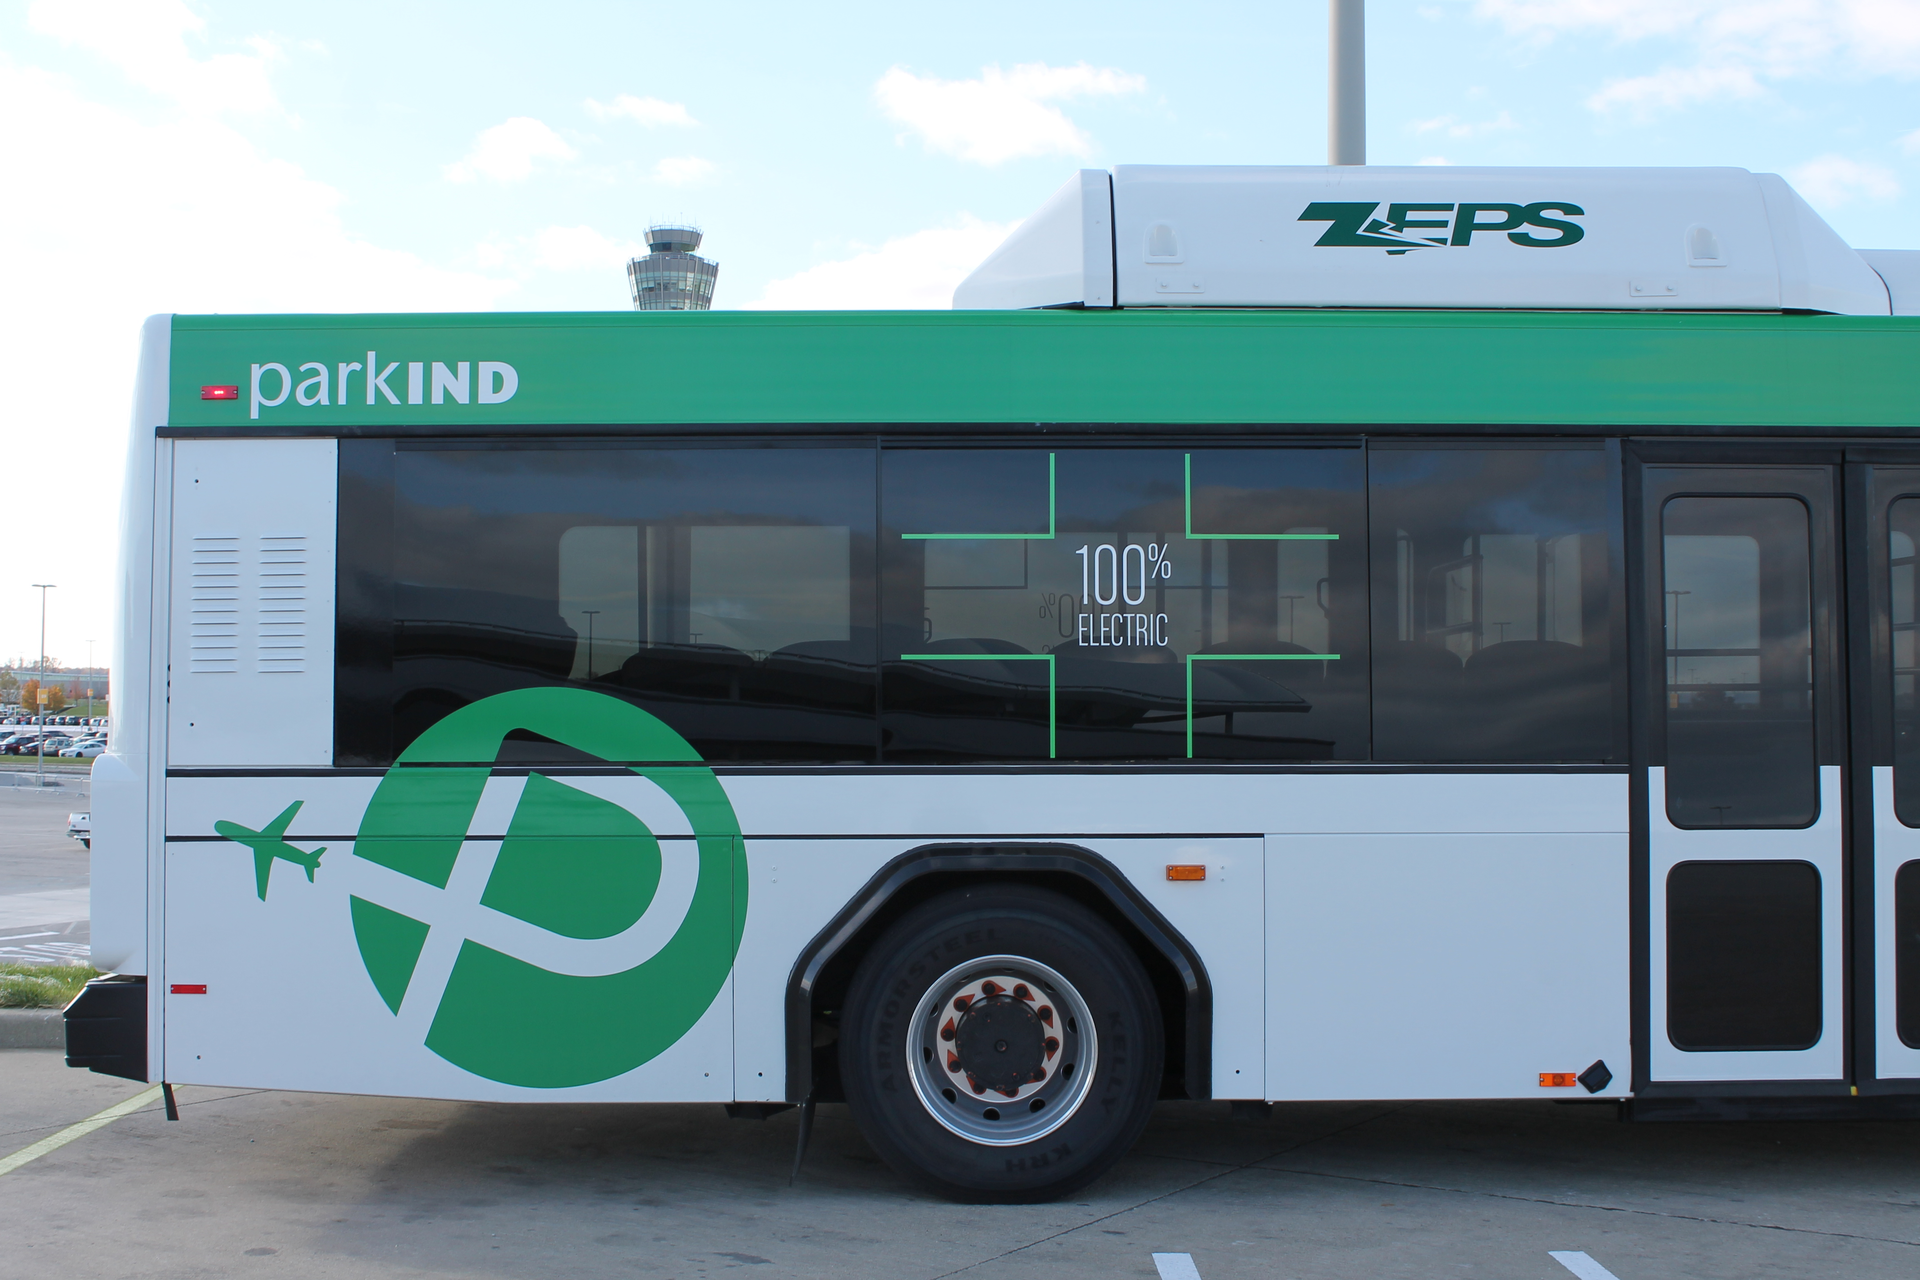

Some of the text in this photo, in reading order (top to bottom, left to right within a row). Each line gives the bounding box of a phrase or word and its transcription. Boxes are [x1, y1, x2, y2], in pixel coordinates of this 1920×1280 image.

[1297, 202, 1585, 255] ZEPS
[250, 351, 519, 420] parkIND
[1075, 543, 1171, 605] 100%
[1078, 613, 1168, 646] ELECTRIC
[877, 928, 999, 1093] ARMORSTEEL
[1101, 1011, 1126, 1113] KELLY
[1005, 1142, 1074, 1173] KRH
